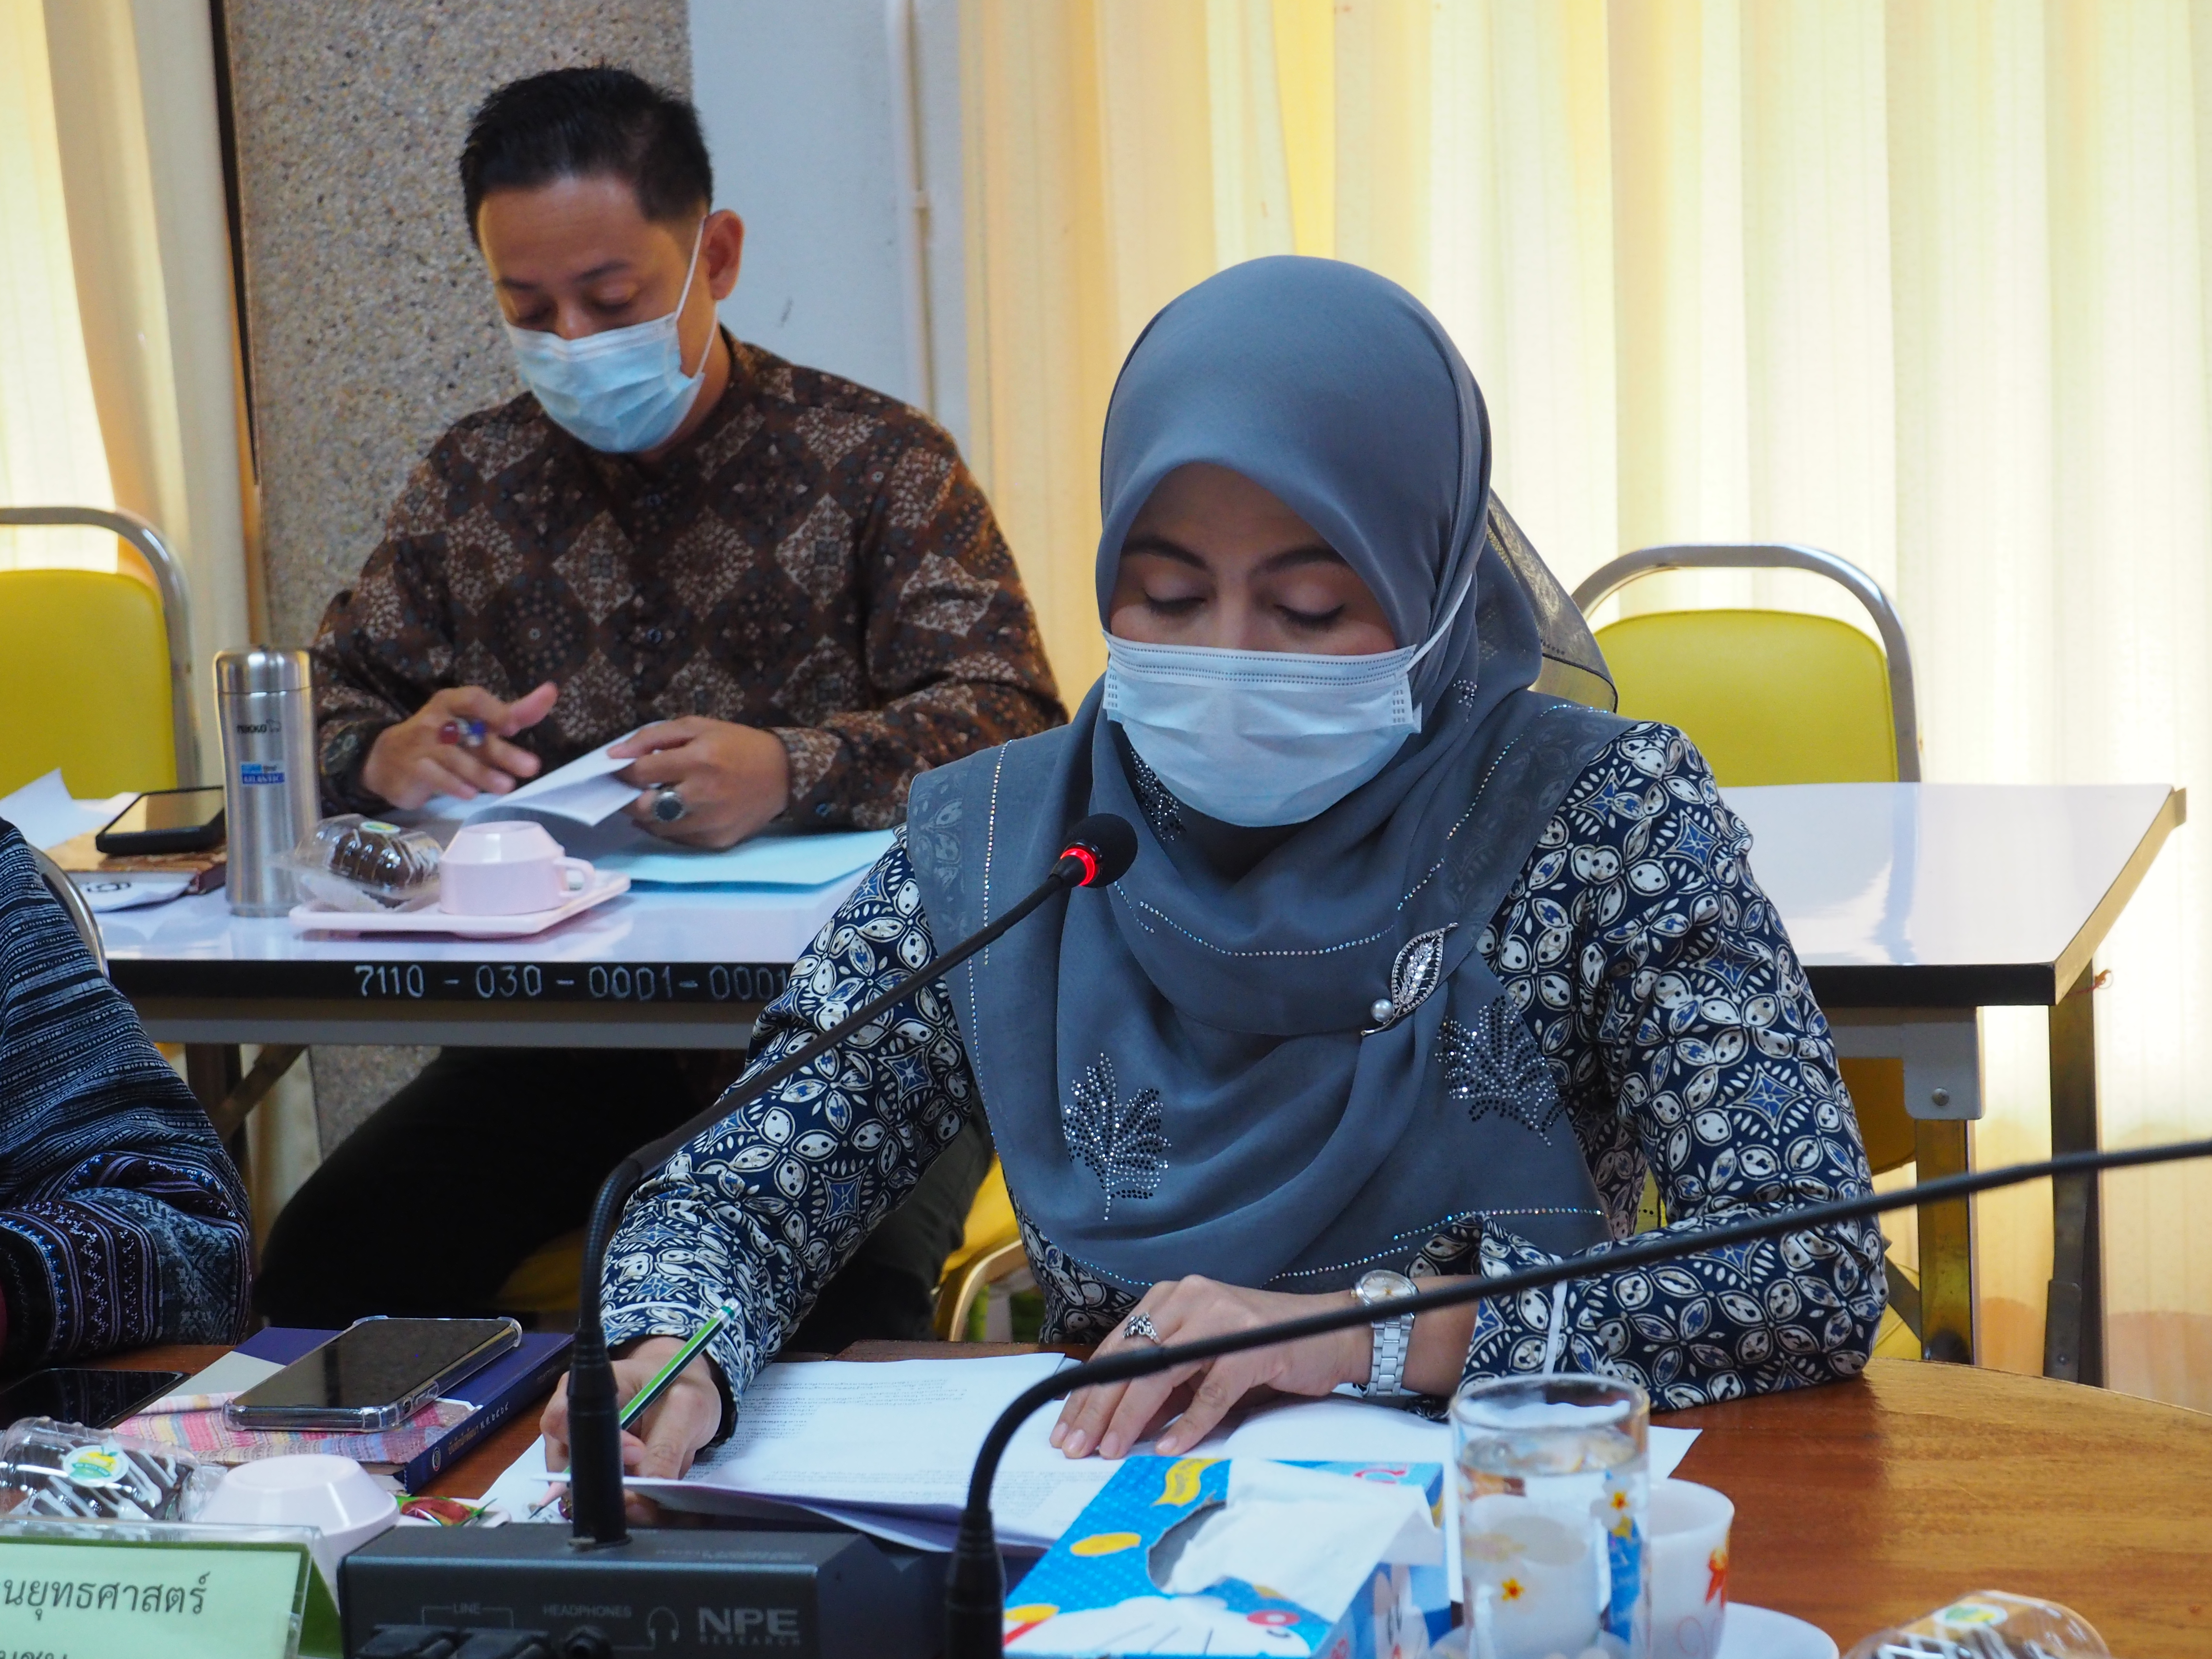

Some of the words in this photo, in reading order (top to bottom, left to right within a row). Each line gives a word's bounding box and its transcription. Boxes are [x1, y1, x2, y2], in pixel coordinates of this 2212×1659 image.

[354, 964, 424, 998] 7110
[475, 964, 542, 998] 030
[0, 1572, 211, 1621] นยุทธศาสตร์
[454, 1603, 480, 1614] LINE
[543, 1604, 632, 1618] HEADPHONES
[699, 1608, 798, 1635] NPE
[699, 1634, 800, 1646] RESEARCH
